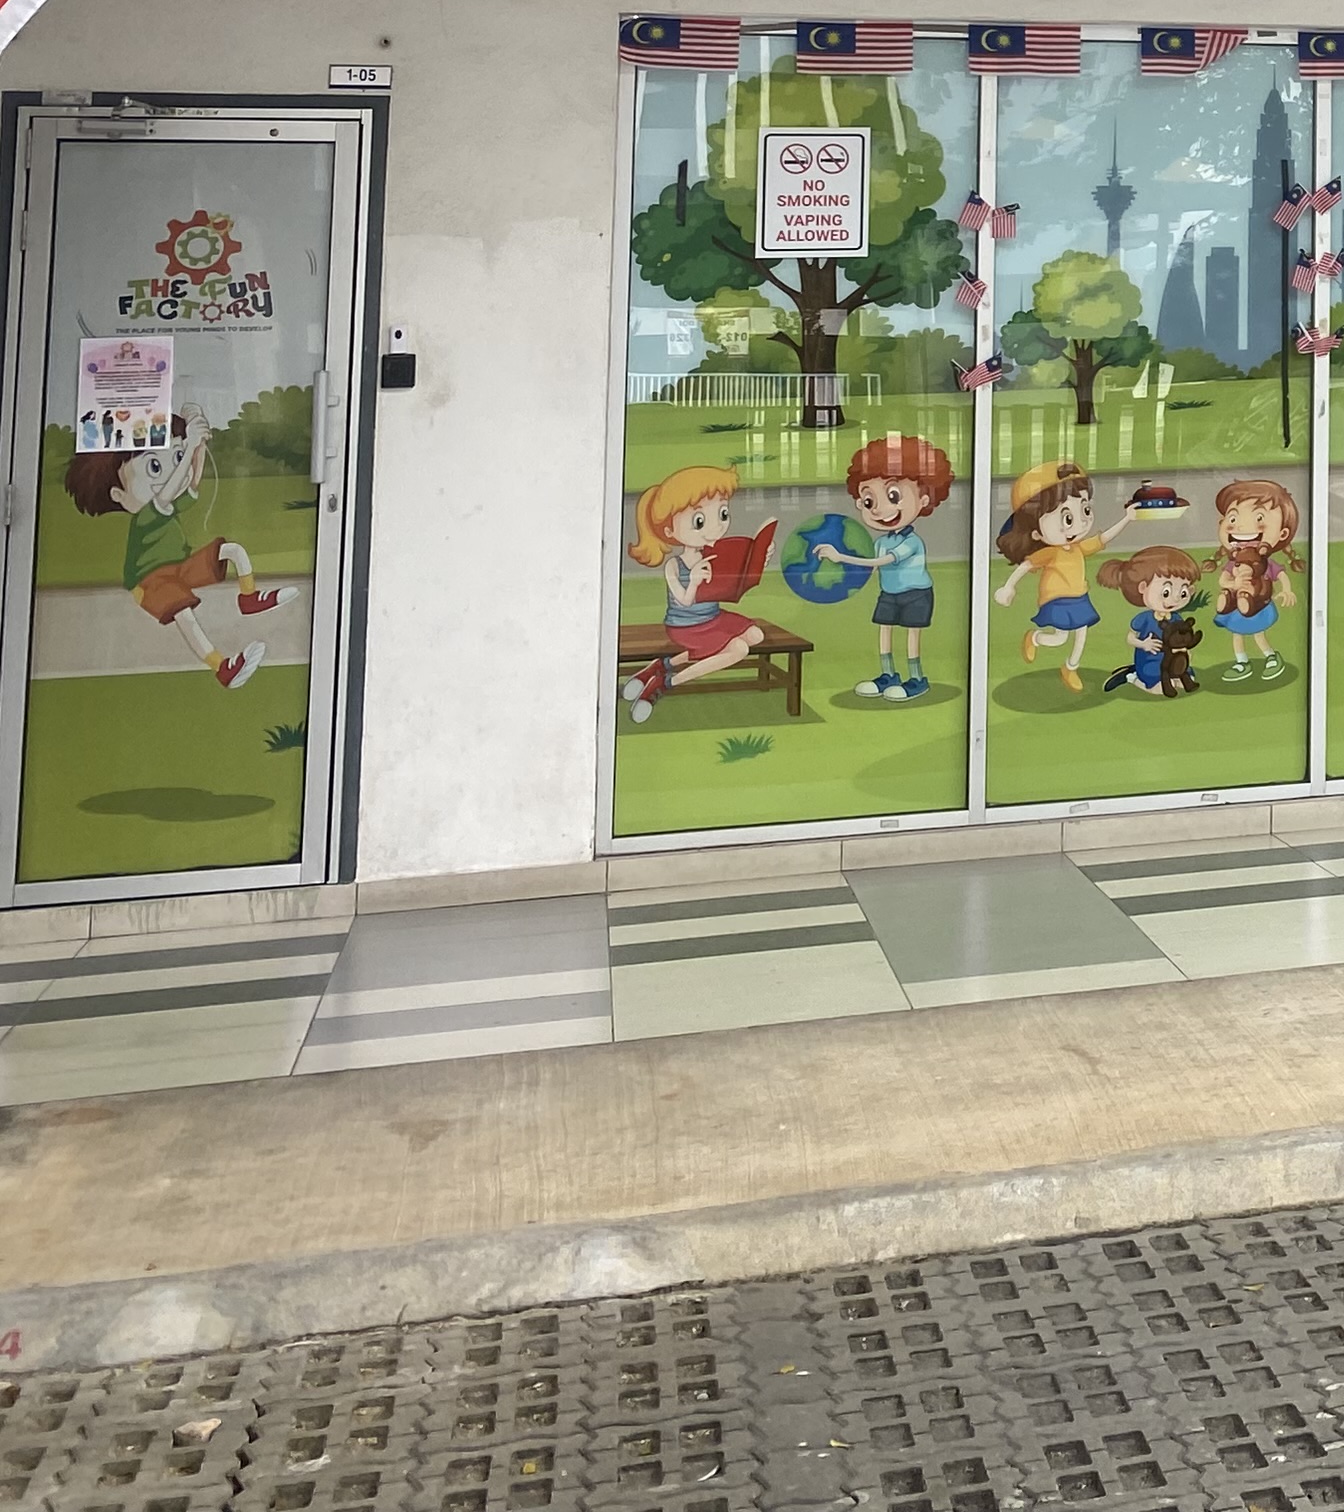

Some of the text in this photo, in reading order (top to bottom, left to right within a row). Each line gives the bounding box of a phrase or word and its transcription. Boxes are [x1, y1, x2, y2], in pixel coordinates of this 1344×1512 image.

[346, 68, 377, 82] 1-05
[803, 179, 825, 192] NO
[776, 194, 850, 207] SMOKING
[783, 214, 843, 226] VAPING
[775, 229, 850, 242] ALLOWED
[128, 271, 270, 301] THE FUN
[119, 291, 273, 323] FACTORY
